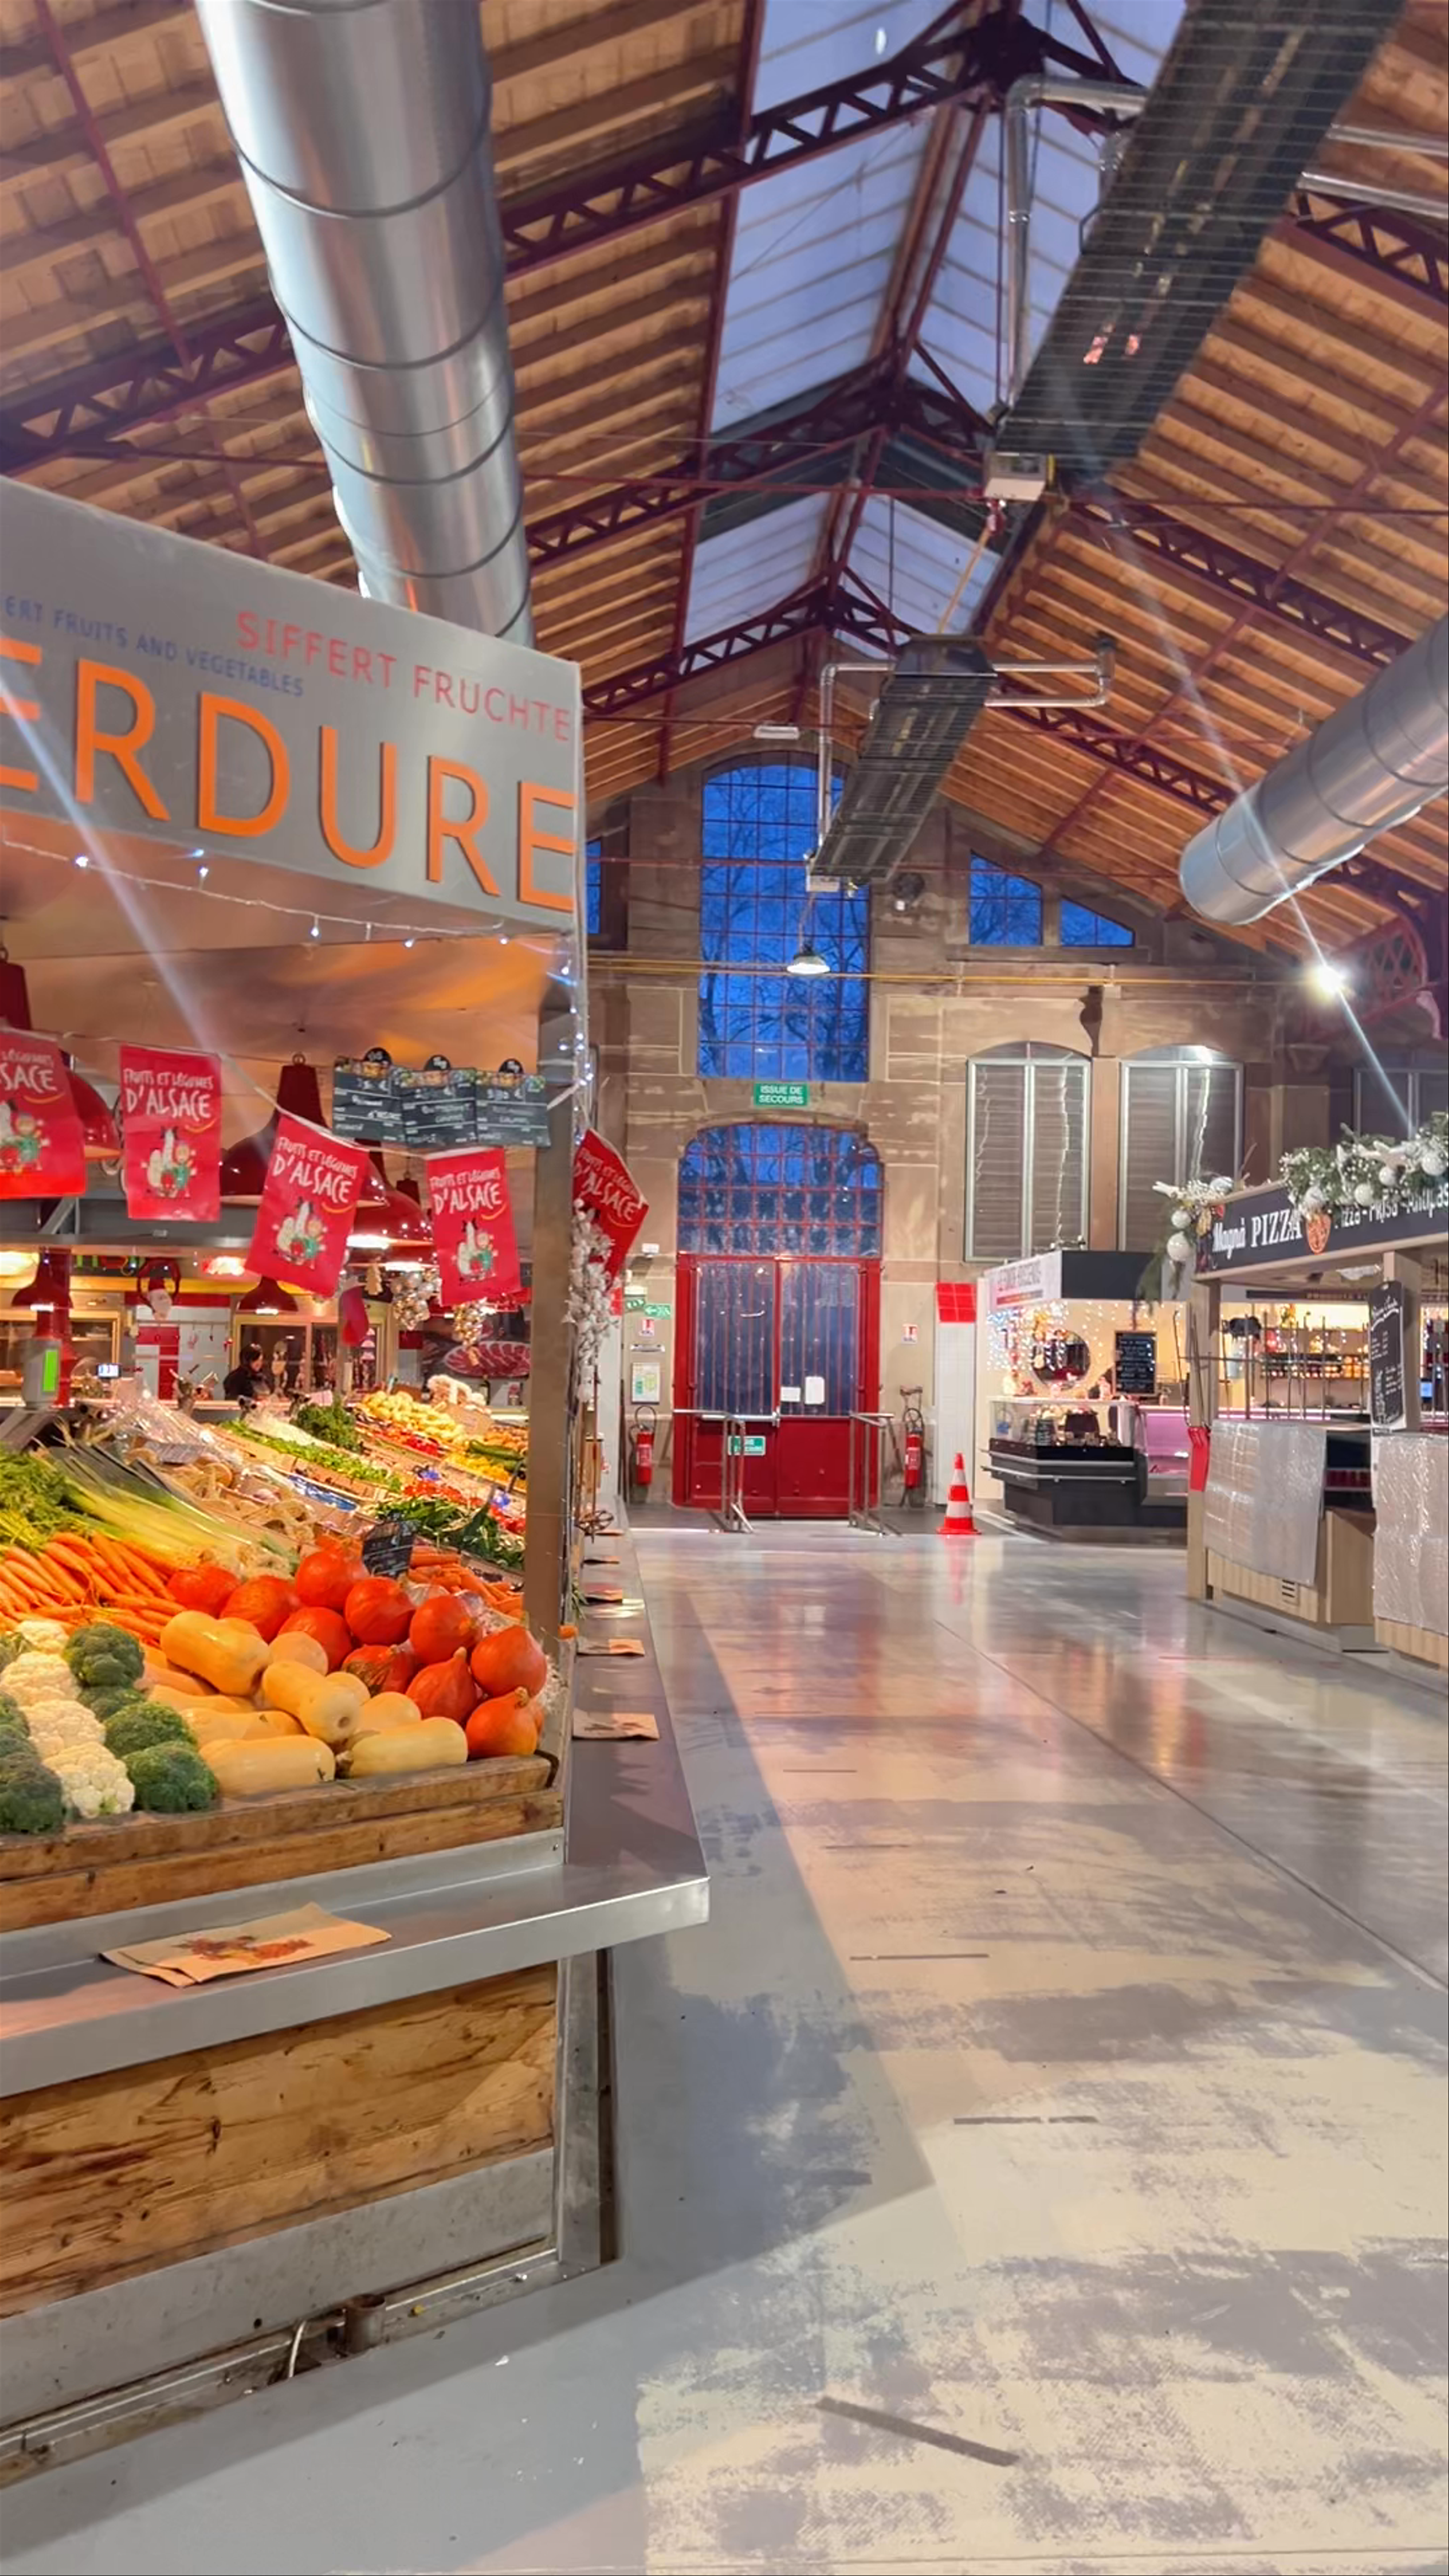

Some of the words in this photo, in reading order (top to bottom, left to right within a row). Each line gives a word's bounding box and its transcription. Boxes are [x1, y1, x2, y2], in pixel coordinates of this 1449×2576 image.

[54, 609, 128, 649] FRUITS
[136, 634, 177, 661] AND
[186, 646, 303, 697] VEGETABLES
[237, 611, 397, 689] SIFFERT
[414, 664, 570, 742] FRUCHTE
[123, 1068, 154, 1085] FRUITS
[156, 1072, 171, 1086] ET
[760, 1086, 788, 1094] ISSUE
[789, 1086, 803, 1095] DE
[125, 1084, 211, 1121] D'ALSACE
[758, 1095, 804, 1104] SECOURS
[277, 1137, 307, 1159] FRUITS
[308, 1150, 322, 1162] ET
[272, 1153, 353, 1203] D'ALSACE
[456, 1171, 468, 1185] ET
[574, 1161, 638, 1221] D'ALSACE
[432, 1182, 502, 1215] D'ALSACE
[1250, 1209, 1303, 1248] PIZZA
